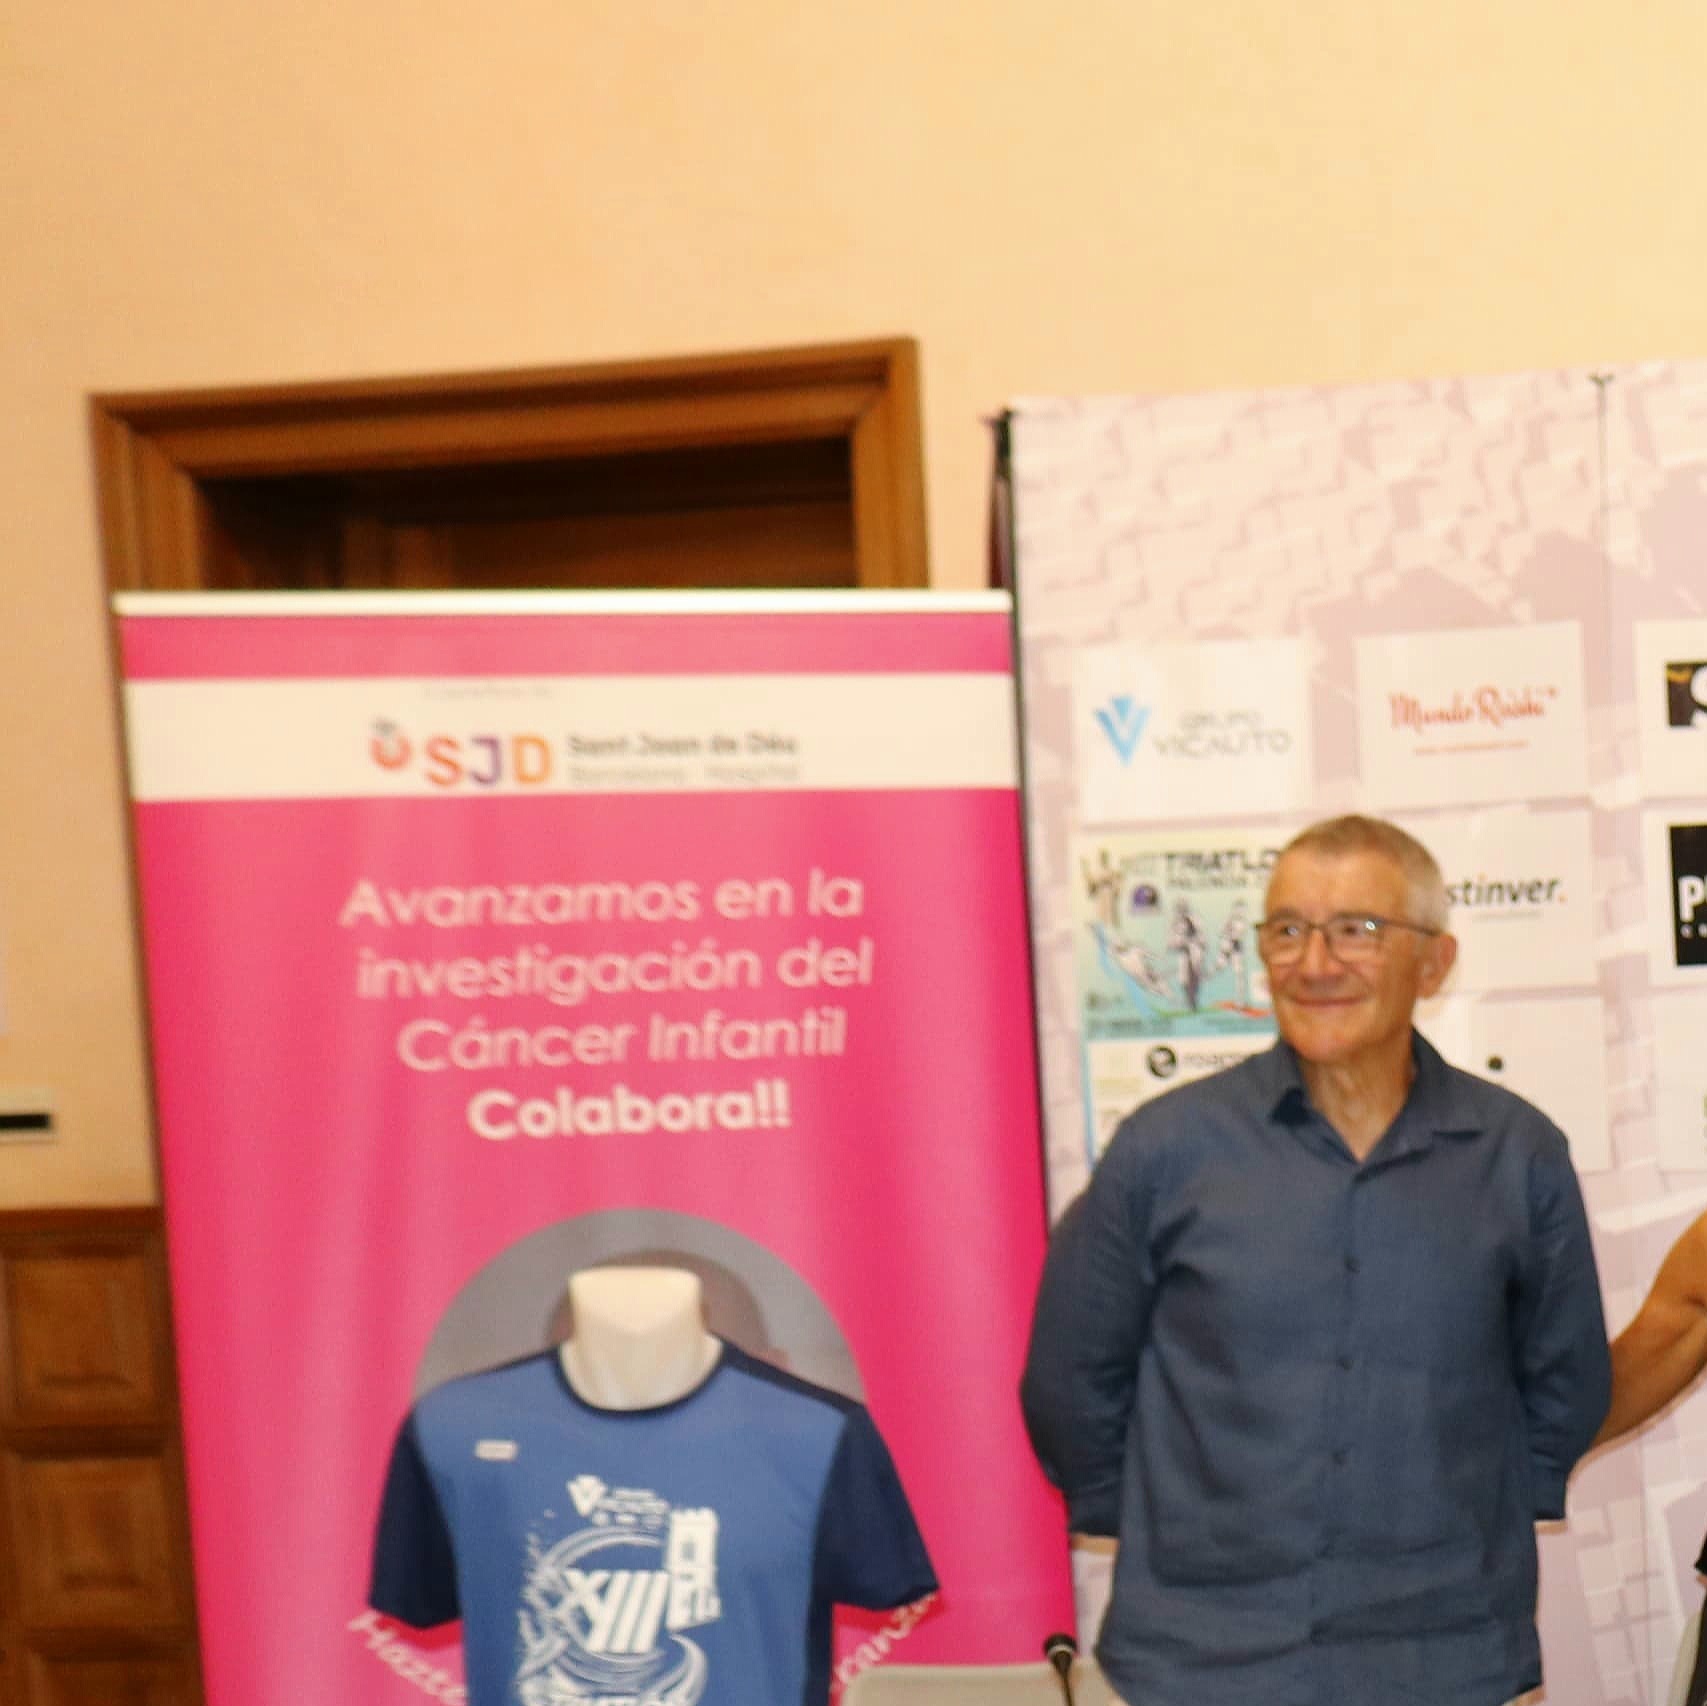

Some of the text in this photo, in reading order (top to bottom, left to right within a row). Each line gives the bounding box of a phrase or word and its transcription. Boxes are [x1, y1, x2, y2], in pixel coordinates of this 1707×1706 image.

[425, 734, 553, 787] SJD
[339, 868, 863, 927] Avanzamos en la
[358, 939, 874, 1005] investigación del
[398, 1008, 845, 1072] Cáncer Infantil
[468, 1081, 792, 1140] Colabora!!
